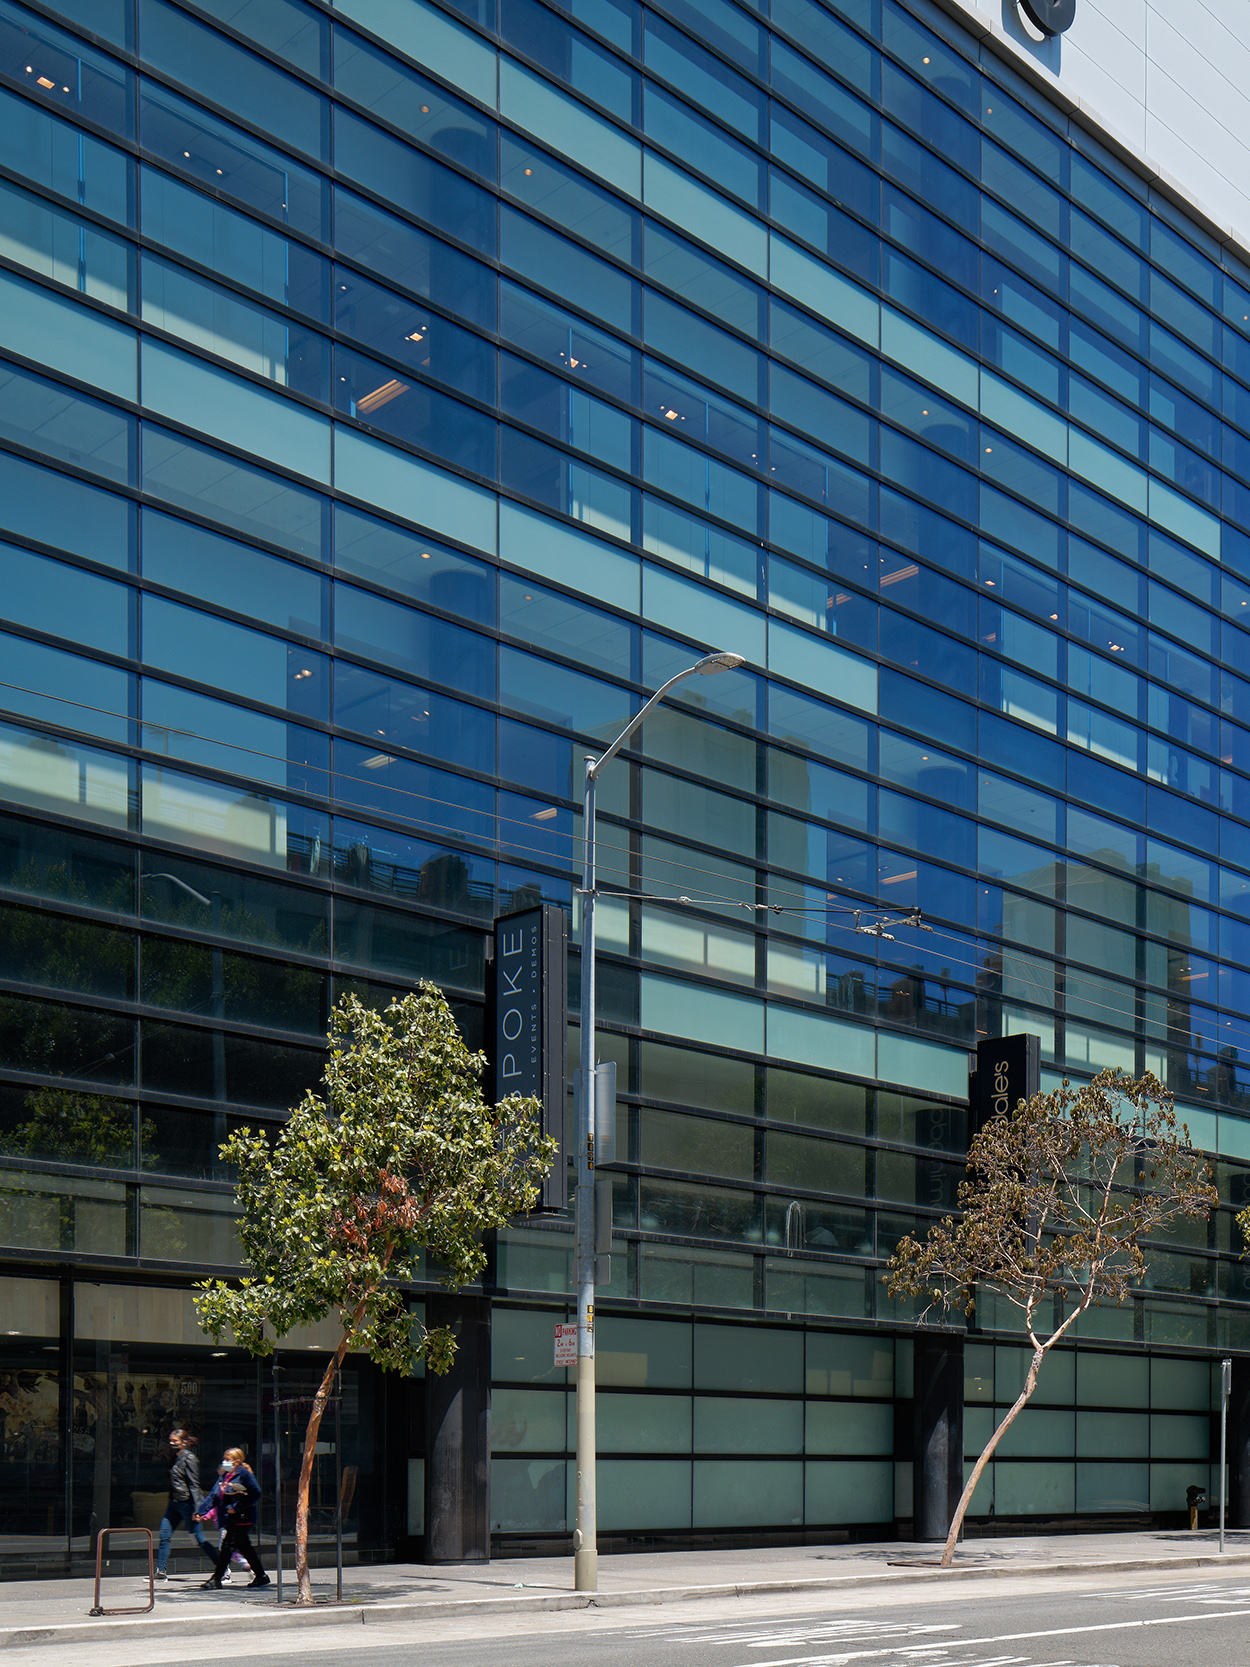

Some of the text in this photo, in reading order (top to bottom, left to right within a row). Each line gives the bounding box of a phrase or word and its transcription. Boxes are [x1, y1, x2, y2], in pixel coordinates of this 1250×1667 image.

[502, 929, 523, 1098] POKE
[991, 1060, 1009, 1124] dale's
[180, 1381, 198, 1395] 500
